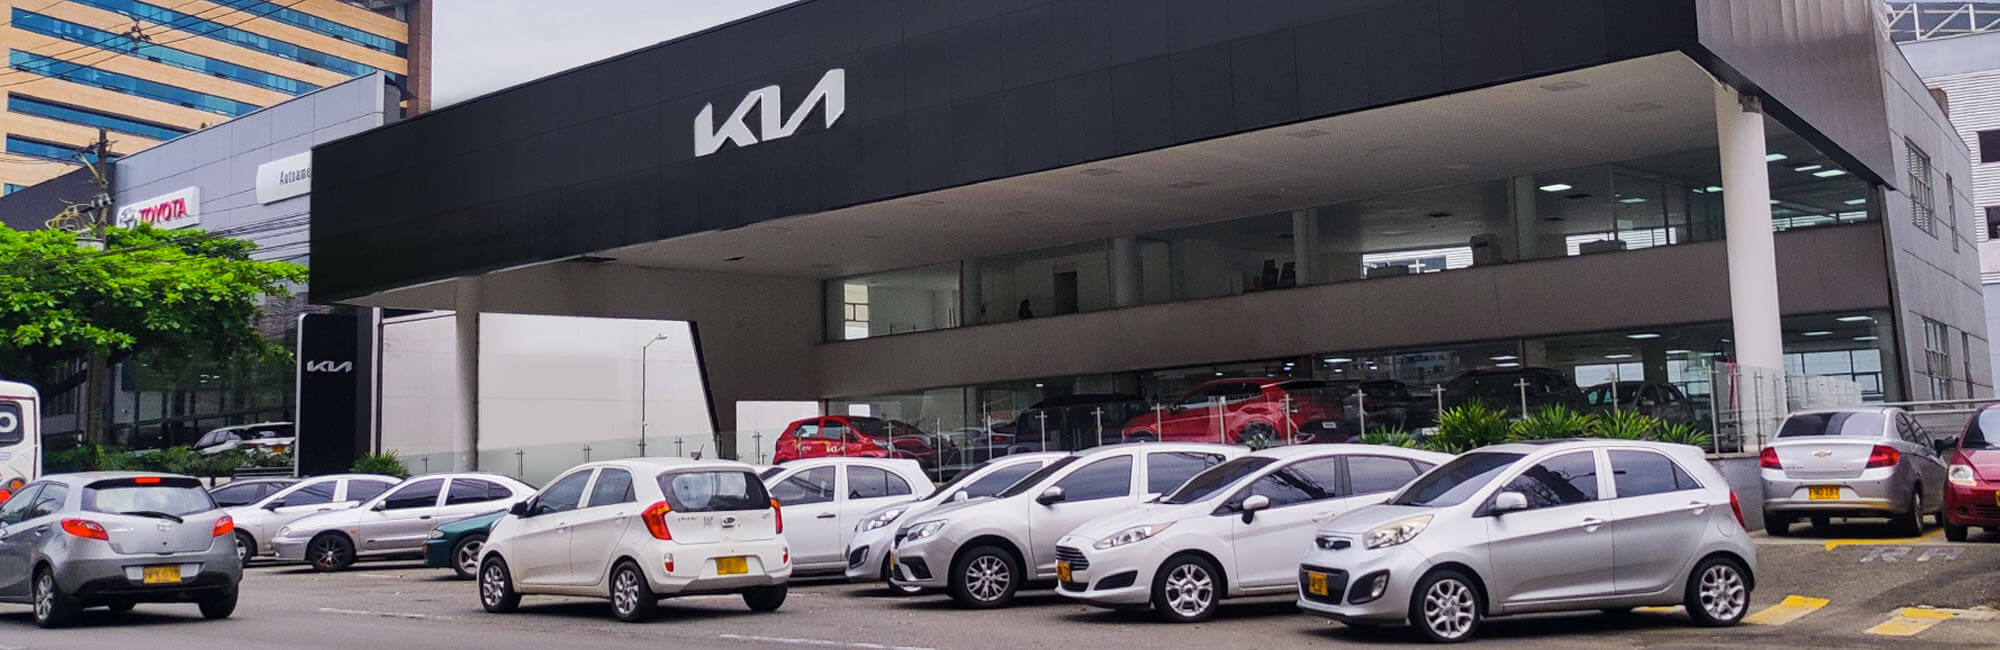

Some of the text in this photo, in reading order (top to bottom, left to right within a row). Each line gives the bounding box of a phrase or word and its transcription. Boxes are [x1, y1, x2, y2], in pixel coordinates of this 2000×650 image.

[694, 68, 845, 157] KIA
[139, 197, 188, 225] TOYOTA
[306, 359, 353, 373] KIA
